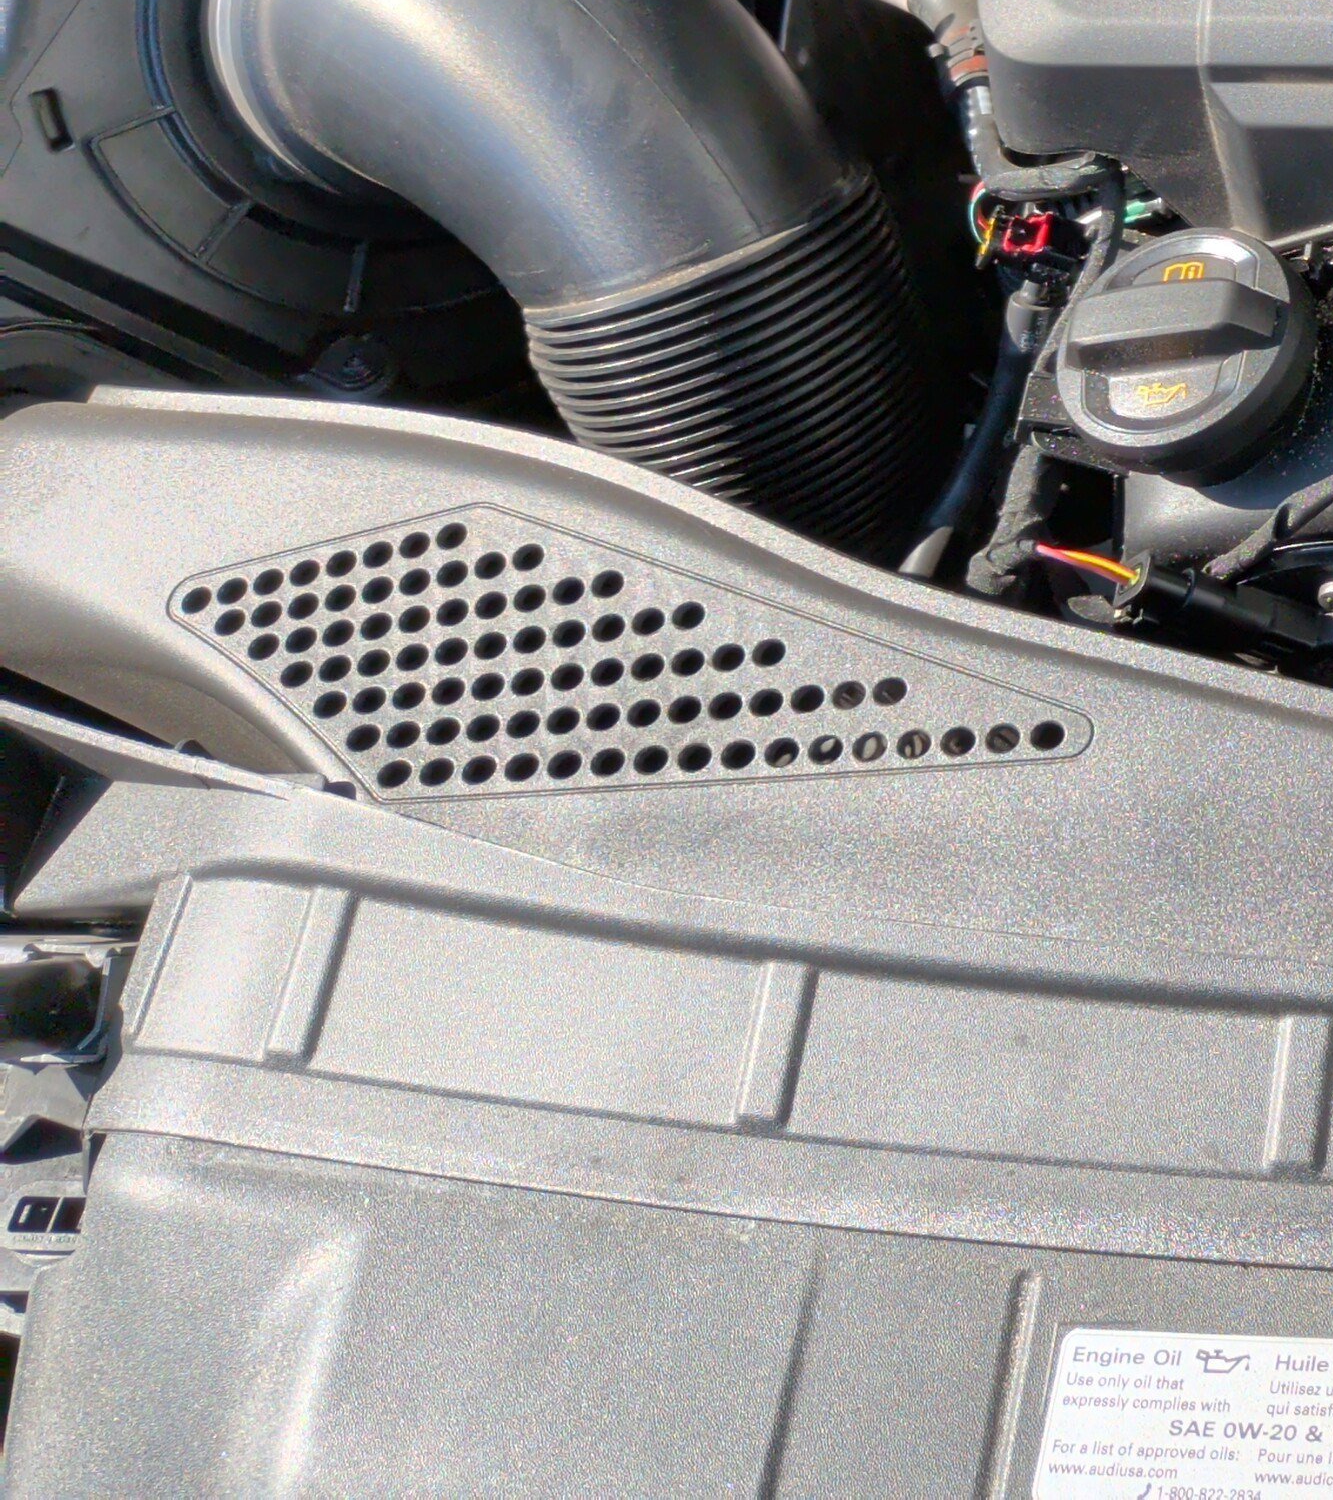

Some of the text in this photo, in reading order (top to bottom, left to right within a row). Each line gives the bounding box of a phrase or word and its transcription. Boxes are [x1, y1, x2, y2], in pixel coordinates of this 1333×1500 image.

[1072, 1346, 1182, 1366] Engine Oil
[1275, 1354, 1330, 1373] Huile
[1066, 1372, 1184, 1391] Use only oil that
[1269, 1381, 1321, 1396] Utilisez
[1062, 1395, 1231, 1414] expressly complies with
[1266, 1402, 1289, 1417] qui
[1168, 1419, 1216, 1438] SAE
[1223, 1422, 1297, 1441] 0W-20
[1305, 1425, 1323, 1443] &
[1053, 1439, 1239, 1464] For a list of approved oils:
[1258, 1448, 1291, 1464] Pour
[1296, 1452, 1324, 1464] une
[1048, 1462, 1178, 1479] www.audiusa.com
[1157, 1485, 1261, 1500] 1-800-822-2834
